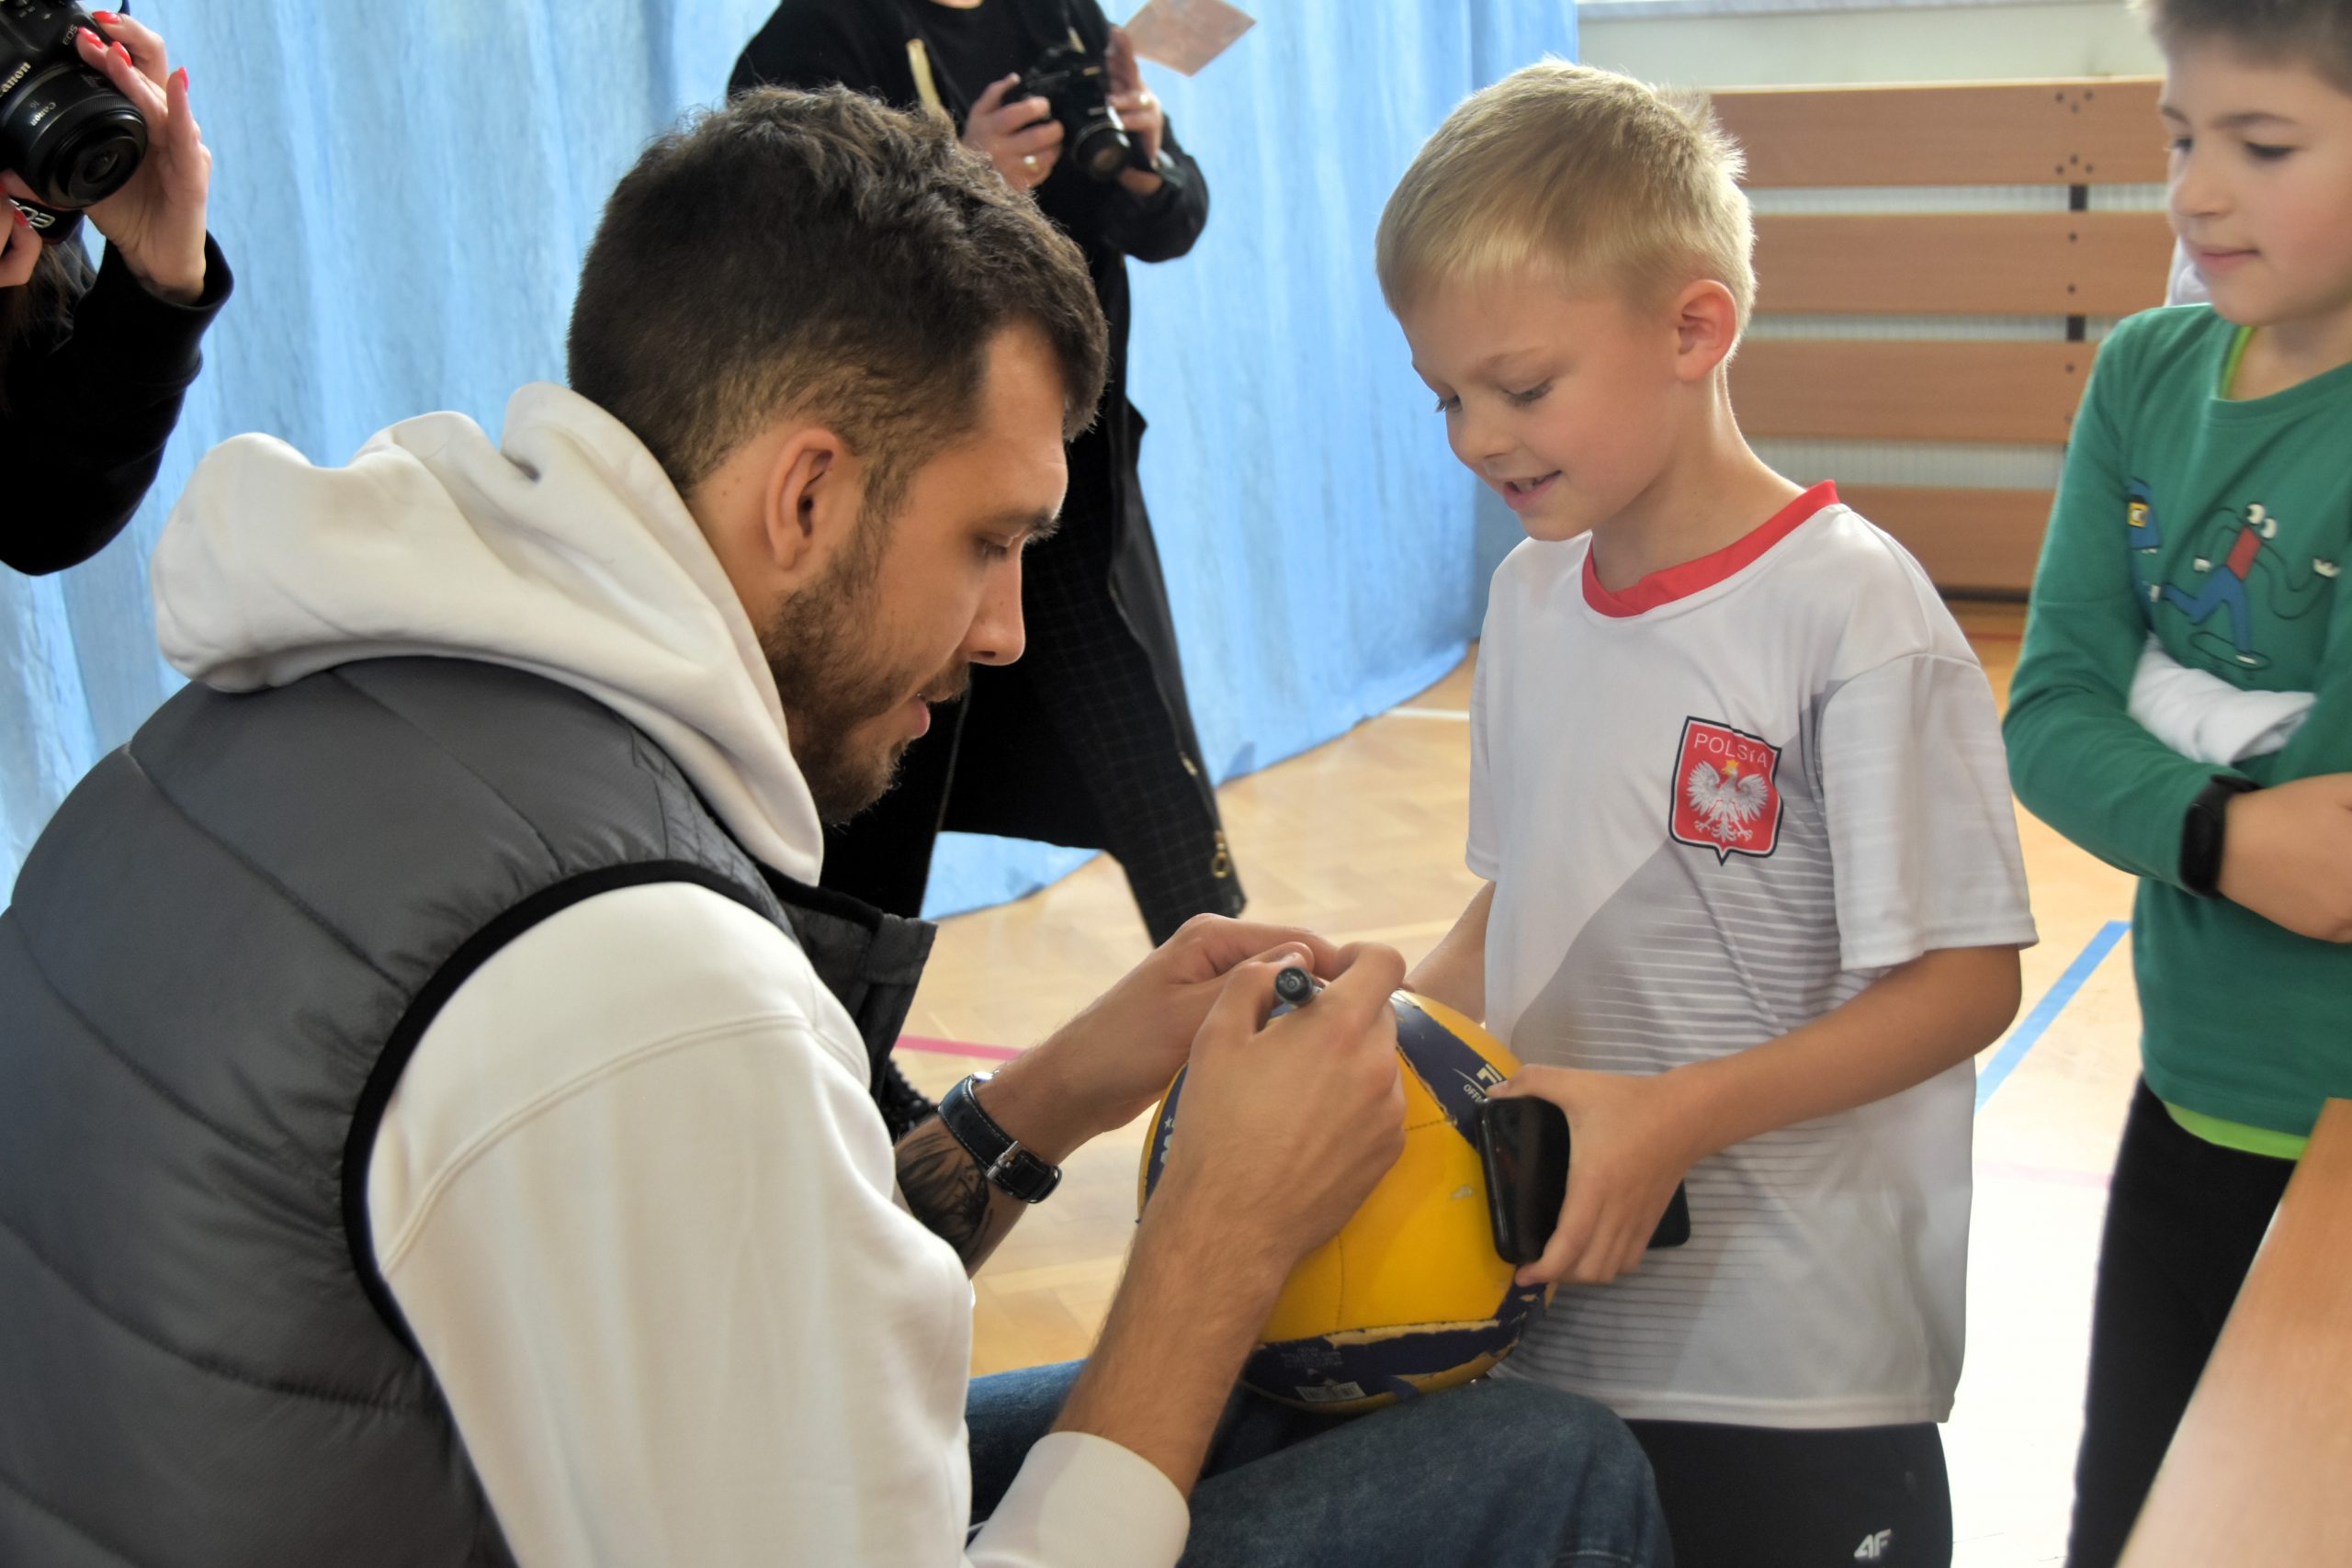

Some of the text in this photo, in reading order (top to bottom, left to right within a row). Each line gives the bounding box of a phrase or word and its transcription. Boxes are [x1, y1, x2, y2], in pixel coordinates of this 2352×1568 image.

[62, 24, 78, 46] EOS
[30, 102, 56, 126] Canon
[1854, 1529, 1892, 1559] 4F
